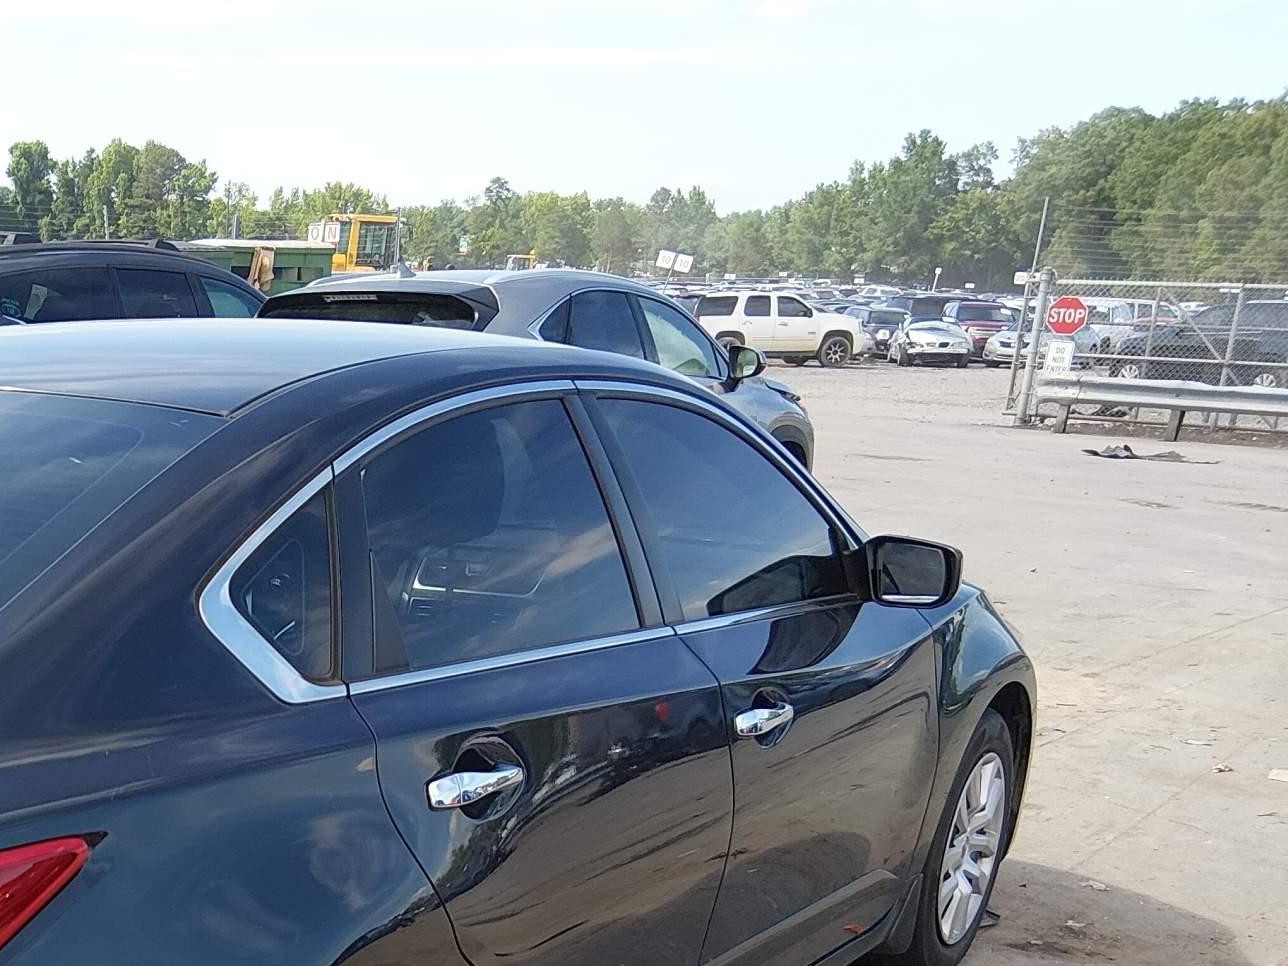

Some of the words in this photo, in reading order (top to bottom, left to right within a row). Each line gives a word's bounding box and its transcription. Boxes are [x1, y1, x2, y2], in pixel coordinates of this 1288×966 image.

[1048, 307, 1085, 324] STOP
[1055, 346, 1066, 354] DO
[1052, 356, 1065, 364] NOT
